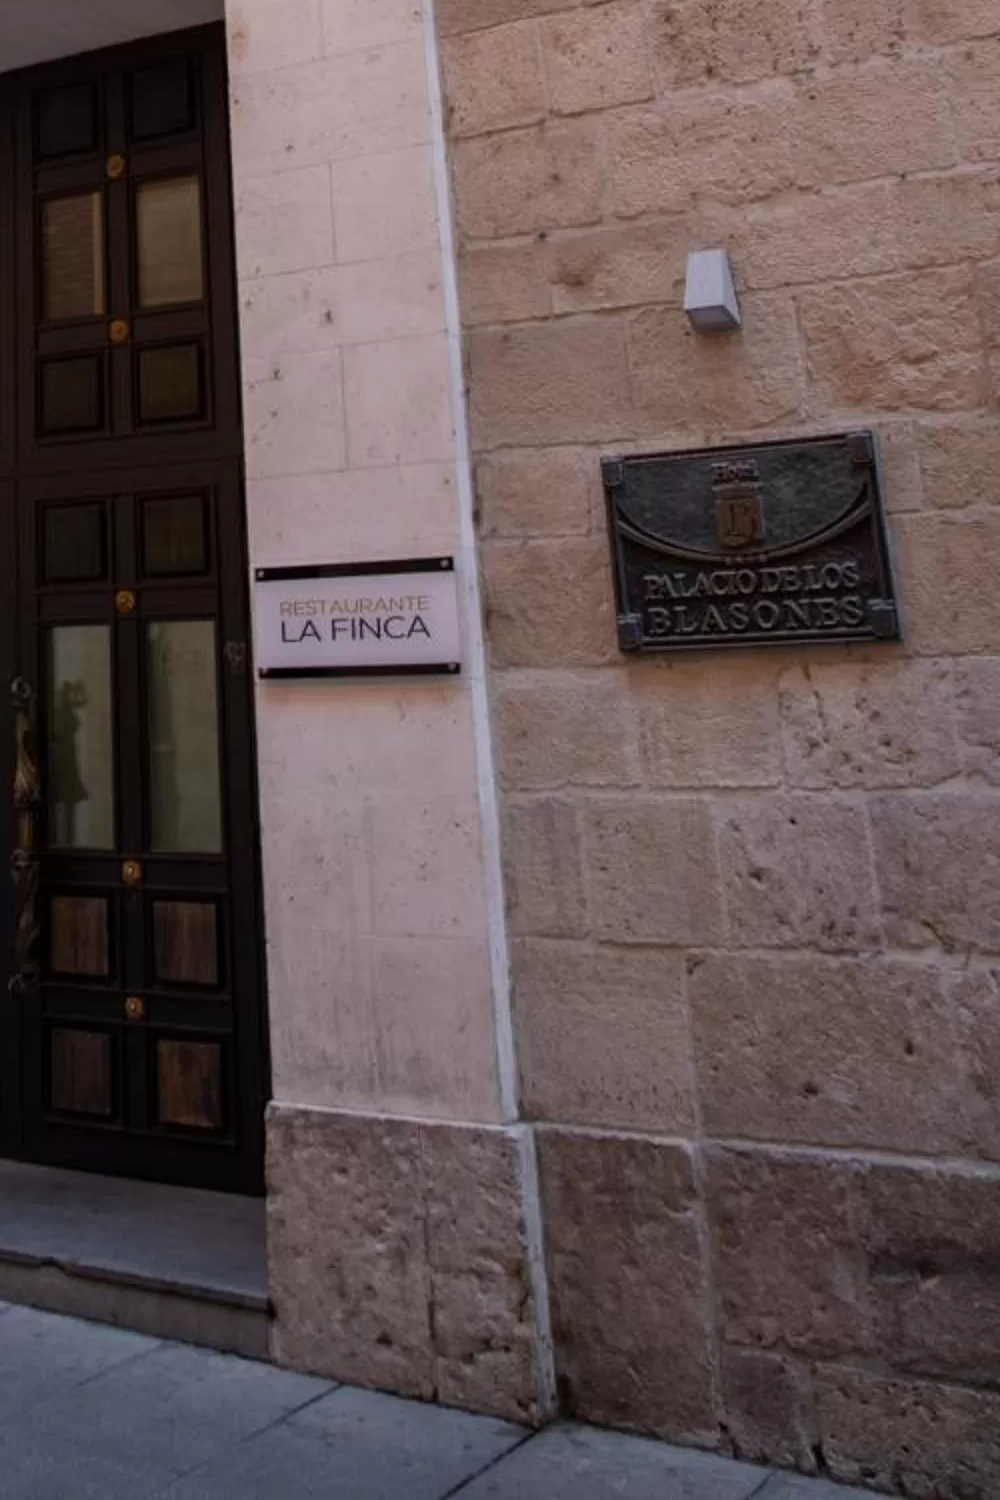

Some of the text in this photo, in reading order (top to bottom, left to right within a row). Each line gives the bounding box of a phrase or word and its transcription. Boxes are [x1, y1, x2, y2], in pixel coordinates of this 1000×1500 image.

[279, 595, 429, 618] RESTAURANTE
[647, 595, 864, 634] BLASONES
[280, 615, 431, 643] LA FINCA
